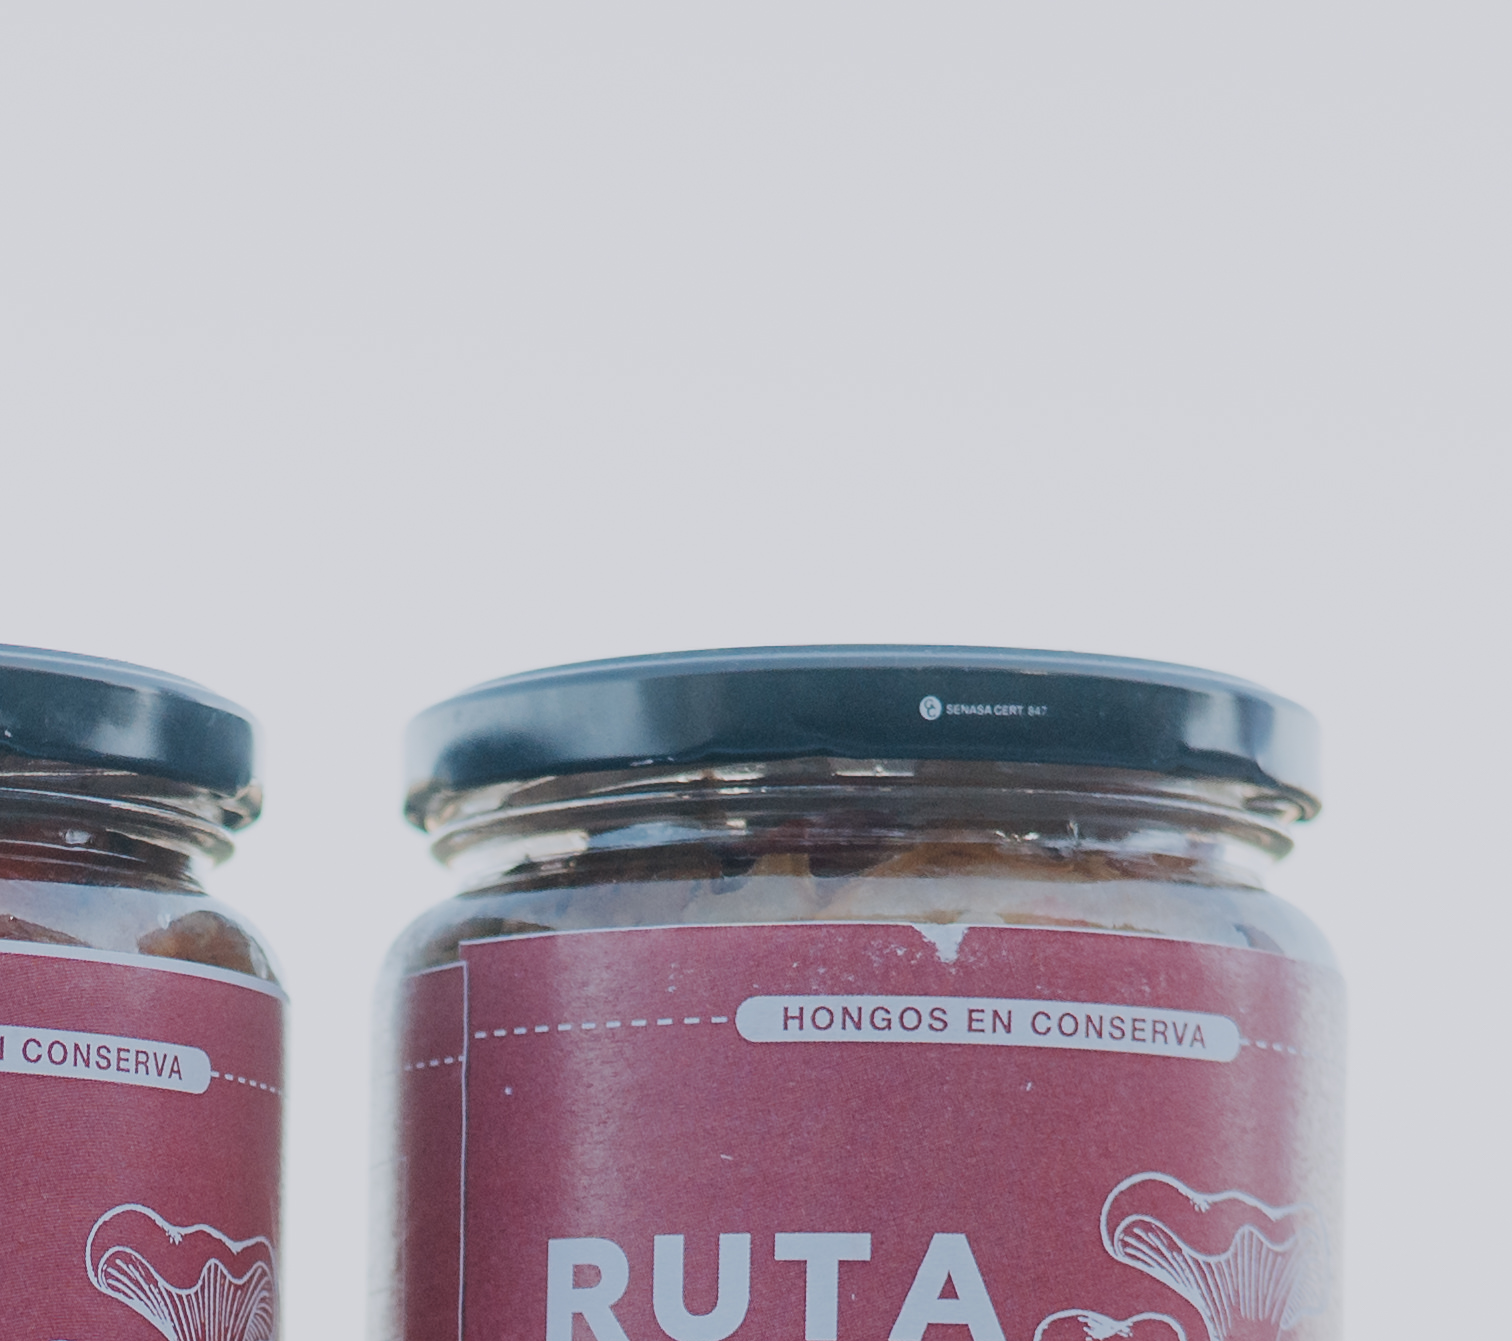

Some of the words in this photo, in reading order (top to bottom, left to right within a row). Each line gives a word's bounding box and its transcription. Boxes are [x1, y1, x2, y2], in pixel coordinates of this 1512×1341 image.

[783, 1006, 948, 1032] HONGOS
[968, 1009, 1011, 1034] EN
[1031, 1011, 1204, 1045] CONSERVA
[20, 1037, 184, 1082] CONSERVA
